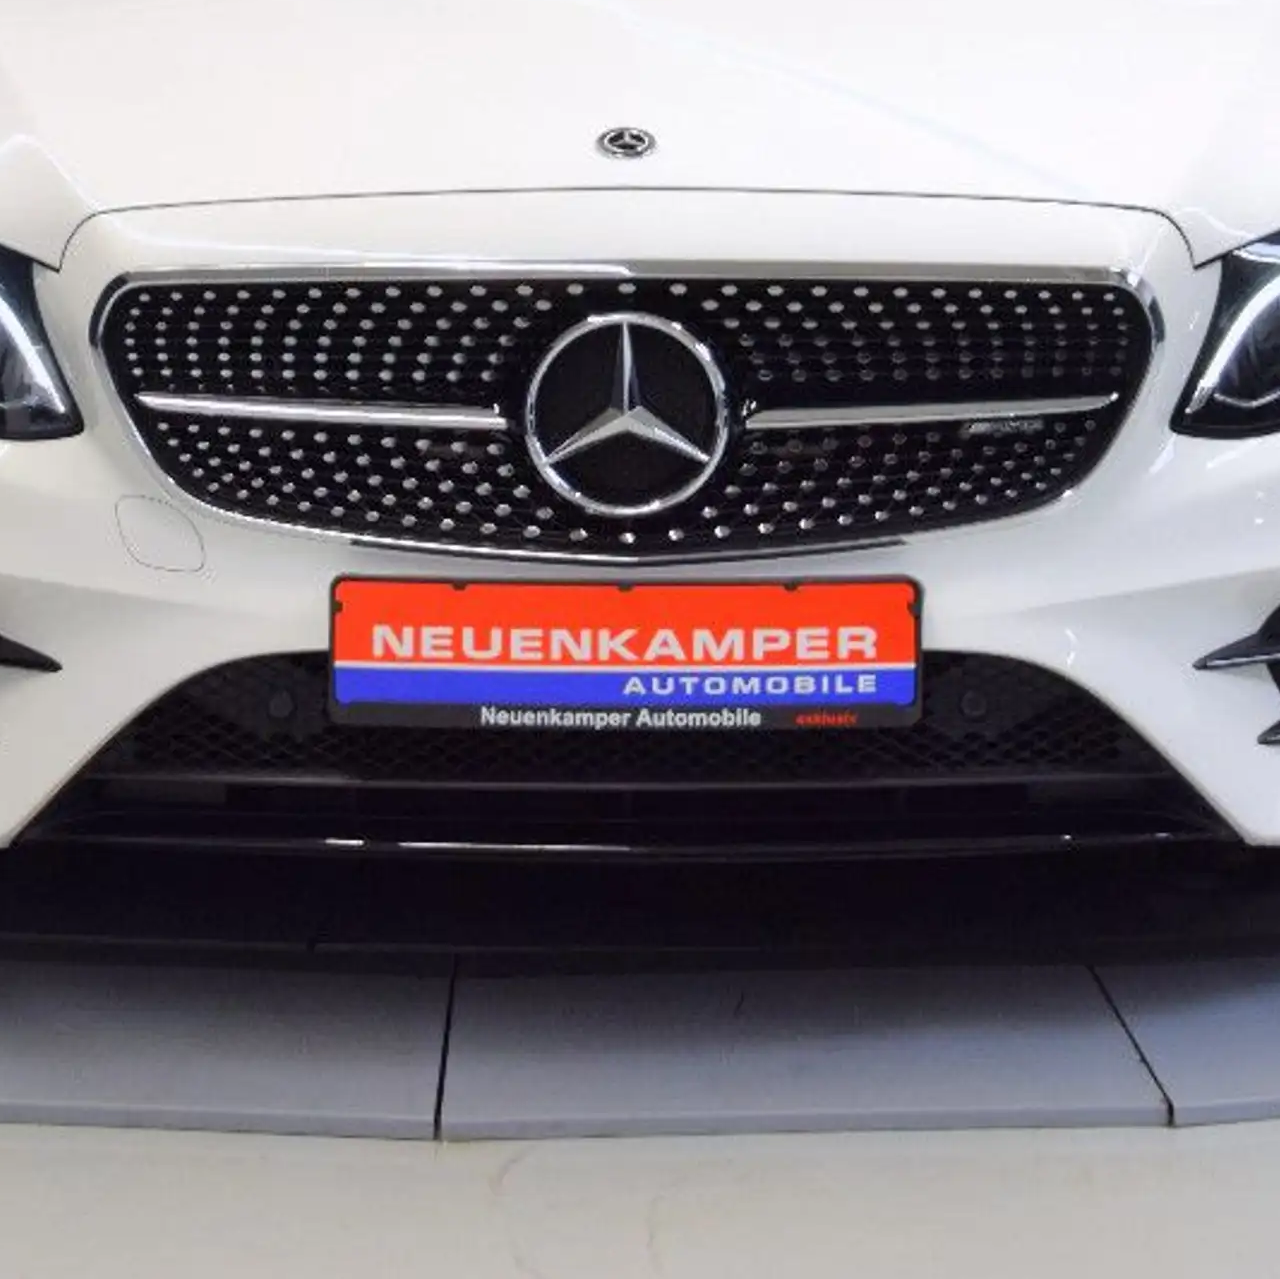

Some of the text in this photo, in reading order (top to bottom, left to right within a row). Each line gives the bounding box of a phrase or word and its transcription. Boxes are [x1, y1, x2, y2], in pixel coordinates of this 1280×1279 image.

[372, 625, 877, 661] NEUENKAMPER
[623, 674, 876, 695] AUTOMOBILE
[480, 705, 762, 730] Neuenkamper Automobile
